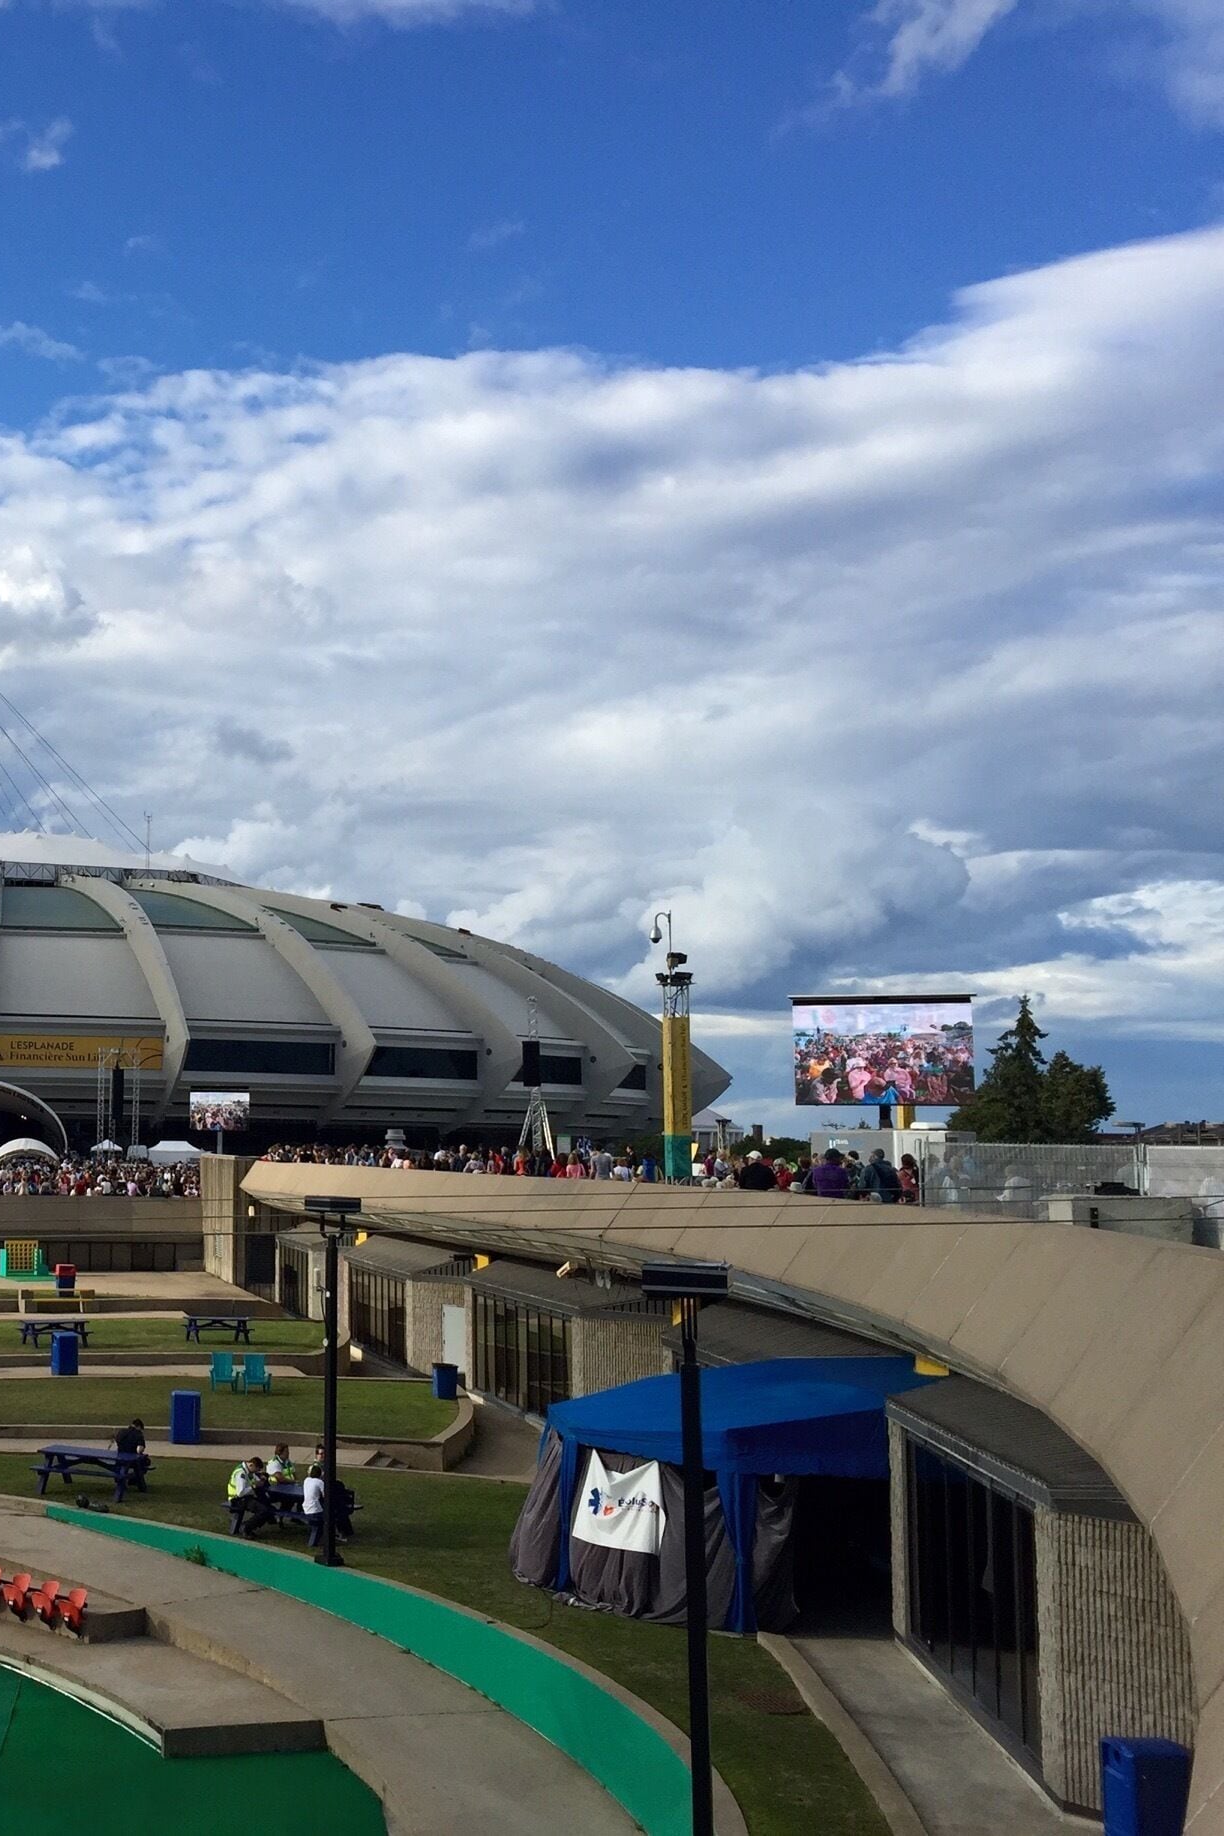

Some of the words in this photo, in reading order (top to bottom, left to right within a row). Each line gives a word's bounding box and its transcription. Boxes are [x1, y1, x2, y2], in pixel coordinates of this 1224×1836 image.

[10, 1040, 75, 1051] L'ESPLANADE
[9, 1050, 66, 1062] Financière
[66, 1052, 86, 1062] Sun
